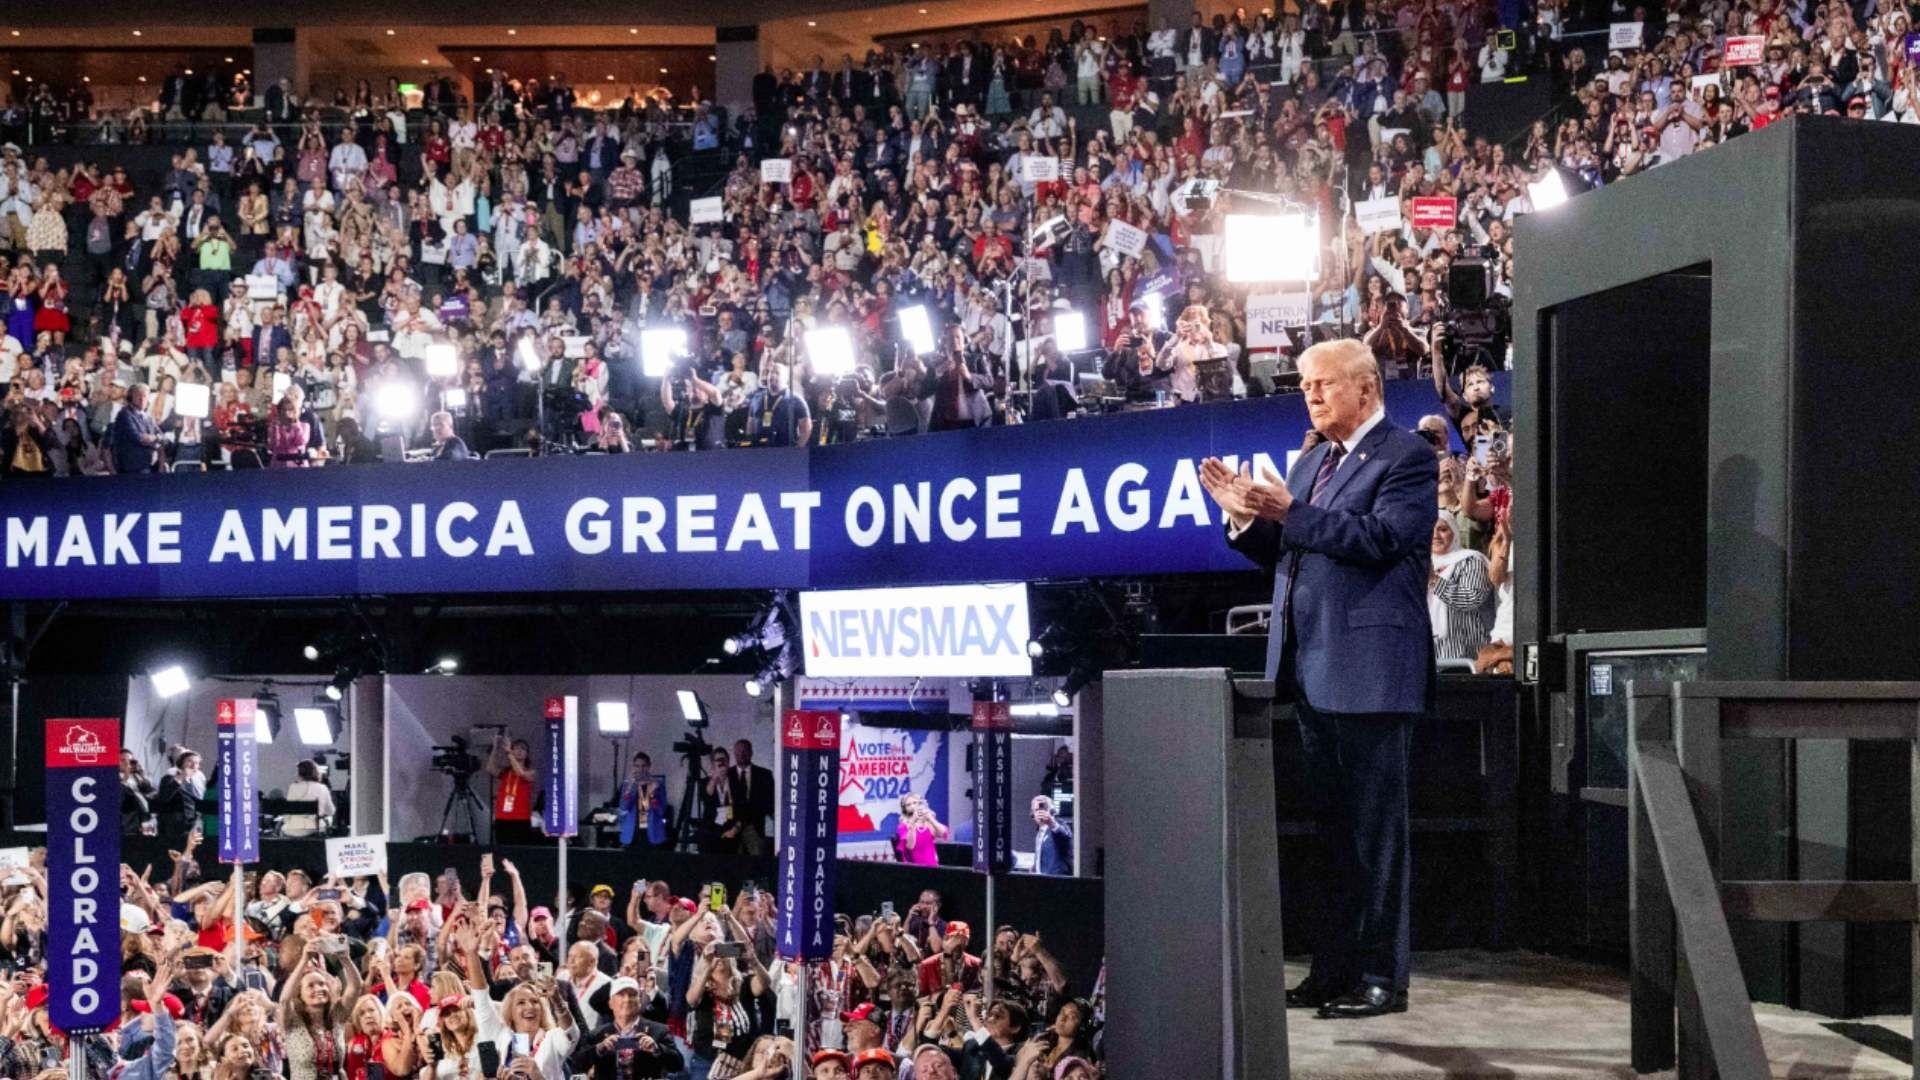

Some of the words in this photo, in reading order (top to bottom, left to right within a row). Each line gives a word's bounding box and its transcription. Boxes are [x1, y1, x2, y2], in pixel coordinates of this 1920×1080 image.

[6, 512, 182, 567] MAKE
[209, 501, 534, 562] AMERICA
[565, 491, 821, 554] GREAT
[845, 474, 1021, 547] ONCE
[810, 604, 1020, 657] NEWSMAX
[789, 754, 799, 836] NORTH
[848, 761, 909, 776] AMERICA
[858, 743, 891, 755] VOTE
[864, 776, 911, 799] 2024
[224, 751, 232, 850] COLUMBIA
[243, 751, 252, 850] COLUMBIA
[817, 755, 829, 838] NORTH
[977, 732, 985, 862] WASHINGTON
[995, 732, 1005, 862] WASHINGTON
[70, 776, 99, 1015] COLORADO
[338, 848, 375, 857] AMERICA
[785, 847, 796, 945] DAKOTA
[812, 847, 825, 946] DAKOTA
